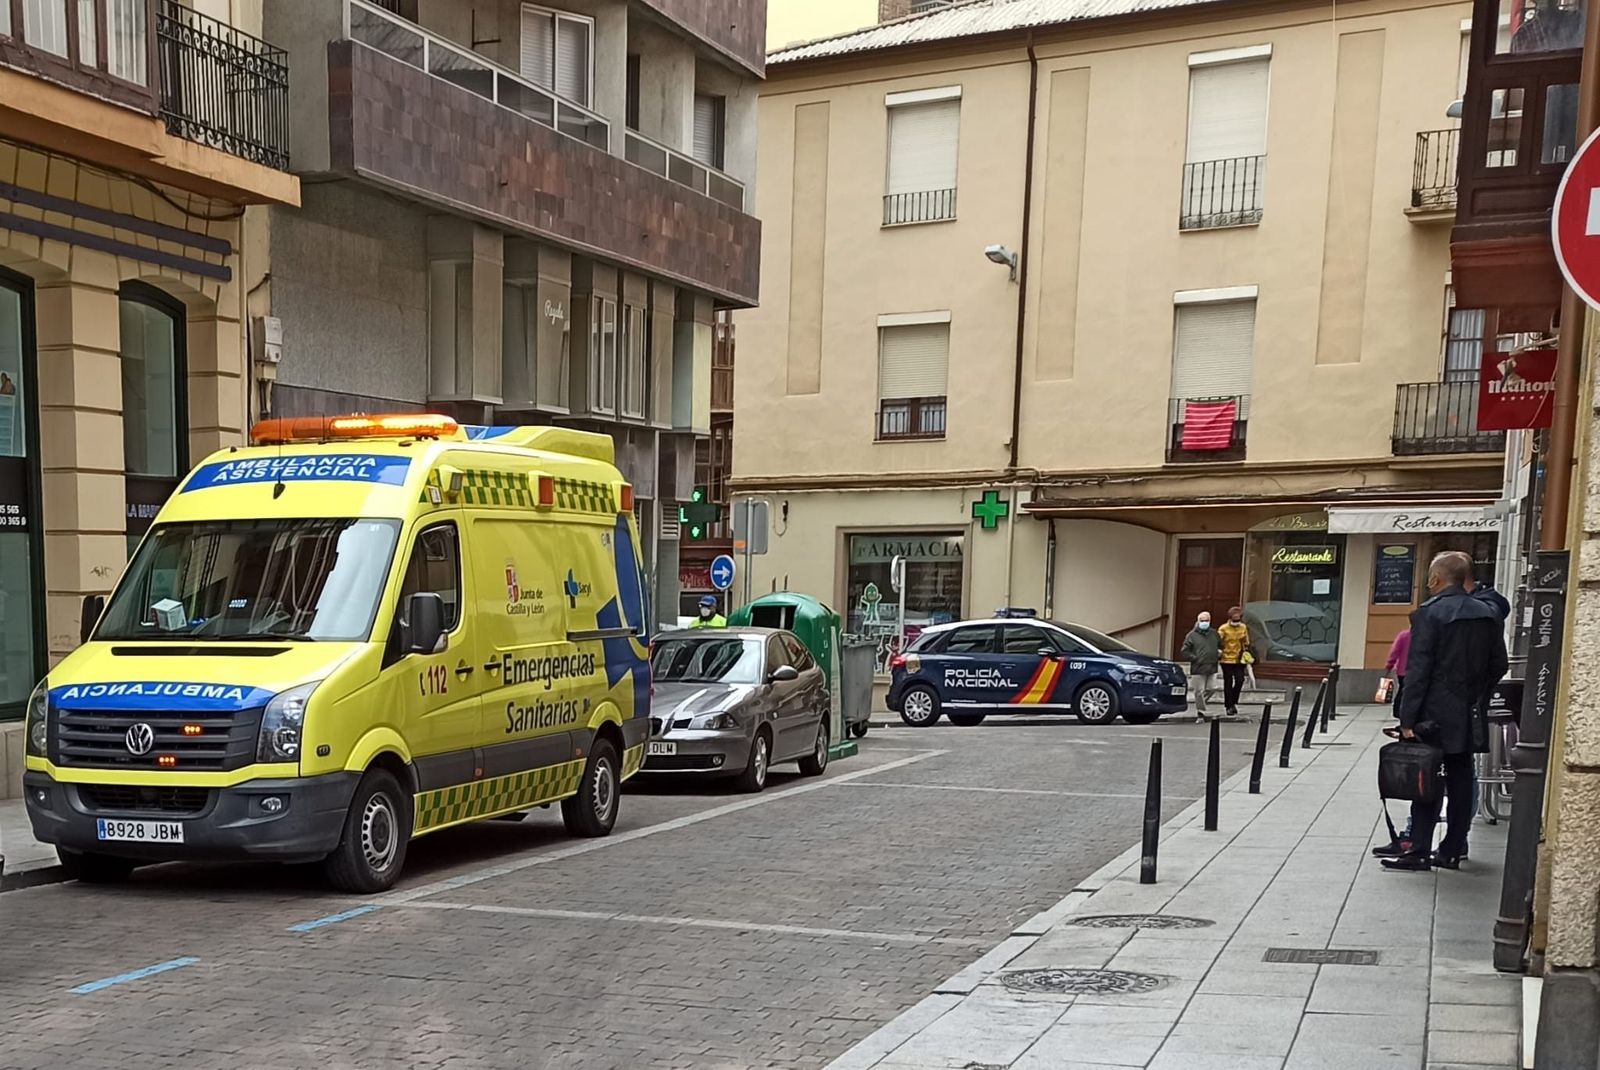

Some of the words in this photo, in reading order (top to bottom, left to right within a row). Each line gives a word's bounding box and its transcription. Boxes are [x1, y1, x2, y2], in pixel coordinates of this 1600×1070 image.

[219, 457, 376, 472] AMBULANCIA
[212, 465, 371, 482] ASISTENCIAL
[1392, 514, 1499, 531] Restaurante
[858, 541, 964, 557] FARMACIA
[1272, 547, 1333, 562] Restaurante
[520, 588, 535, 600] Junta
[535, 588, 543, 599] de
[506, 603, 527, 615] Castilla
[531, 601, 545, 614] León
[503, 648, 596, 690] Emergencias
[427, 664, 448, 695] 112
[944, 679, 1018, 688] NACIONAL
[505, 696, 578, 734] Sanitarias
[107, 822, 145, 839] 8928
[151, 823, 179, 840] JBM
